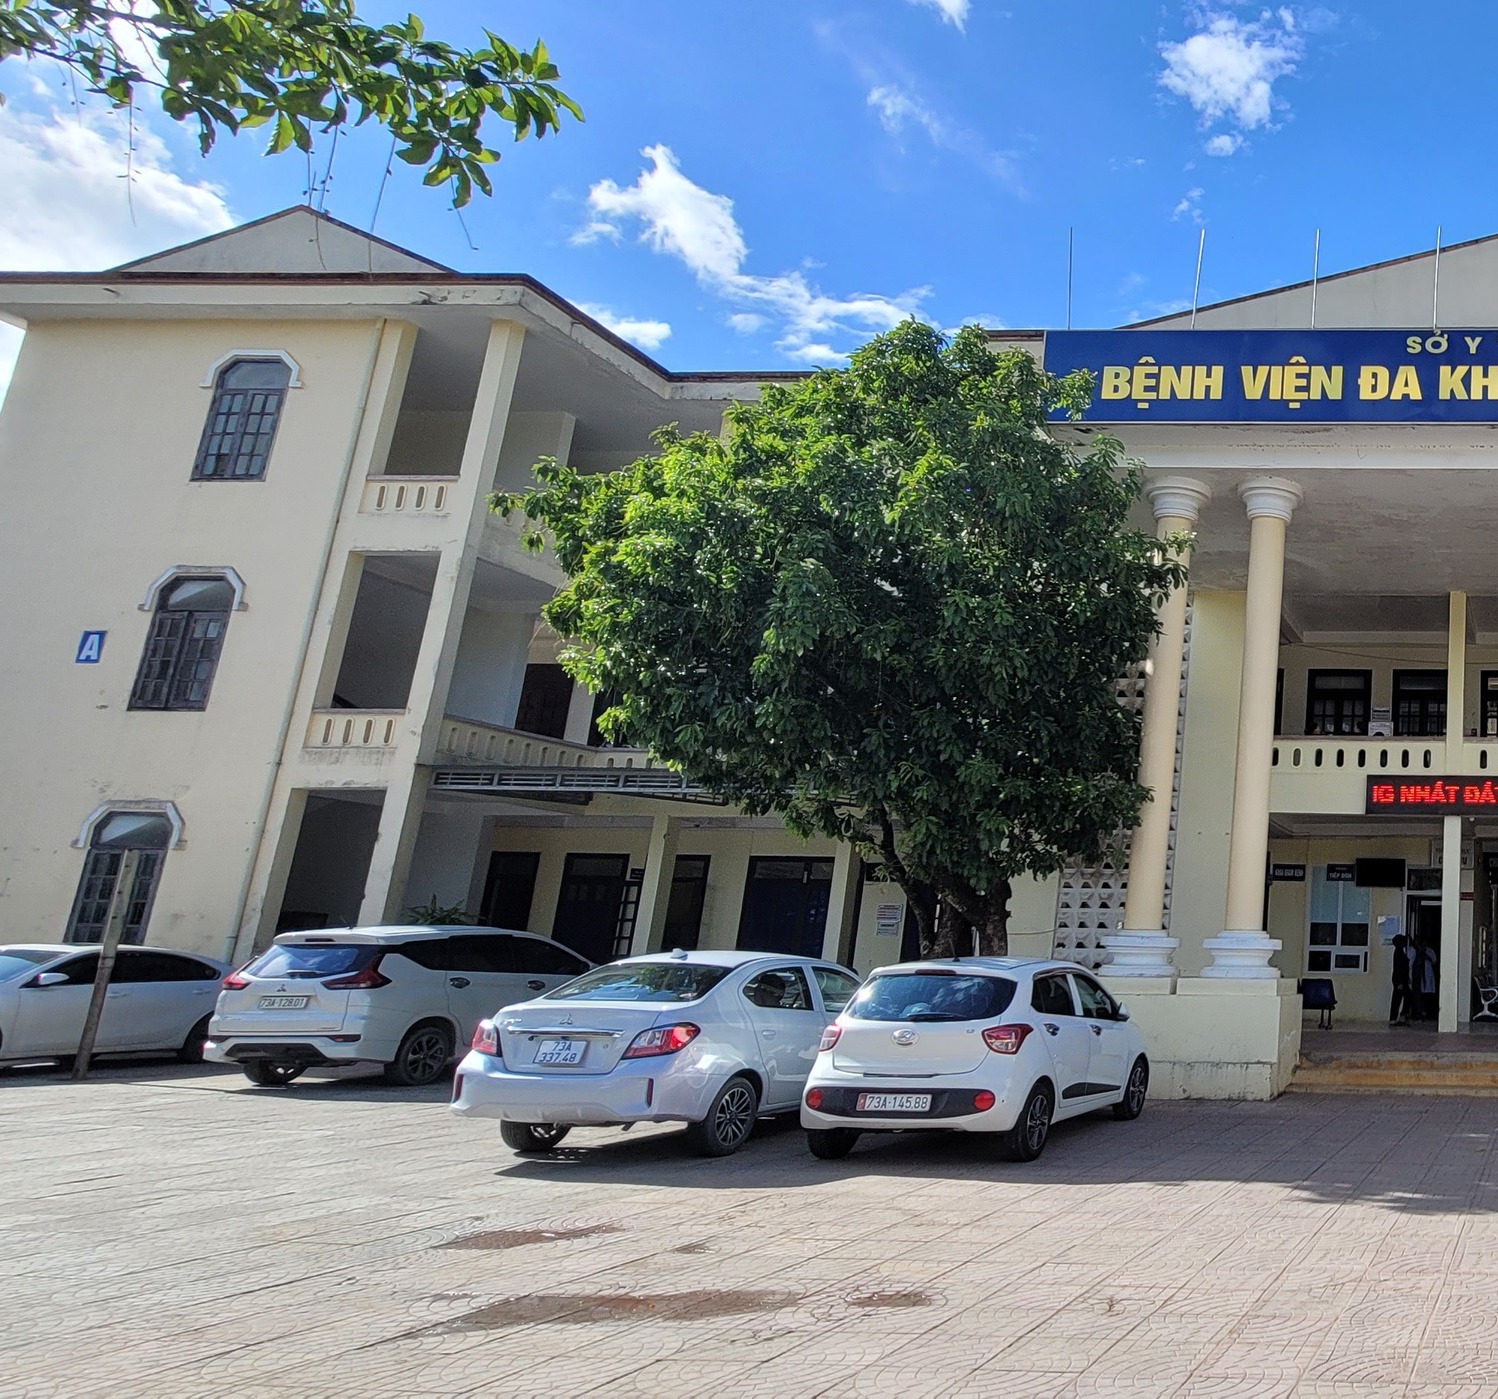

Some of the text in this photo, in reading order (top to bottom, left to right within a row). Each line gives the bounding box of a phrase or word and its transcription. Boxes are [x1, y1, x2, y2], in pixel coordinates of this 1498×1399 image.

[1406, 329, 1448, 354] SỞ
[1464, 336, 1483, 354] Y
[1100, 356, 1224, 409] BỆNH
[1240, 355, 1344, 409] VIỆN
[1357, 365, 1423, 401] ĐA
[78, 634, 100, 660] A
[539, 1052, 577, 1063] 337.48
[552, 1041, 572, 1052] 73A
